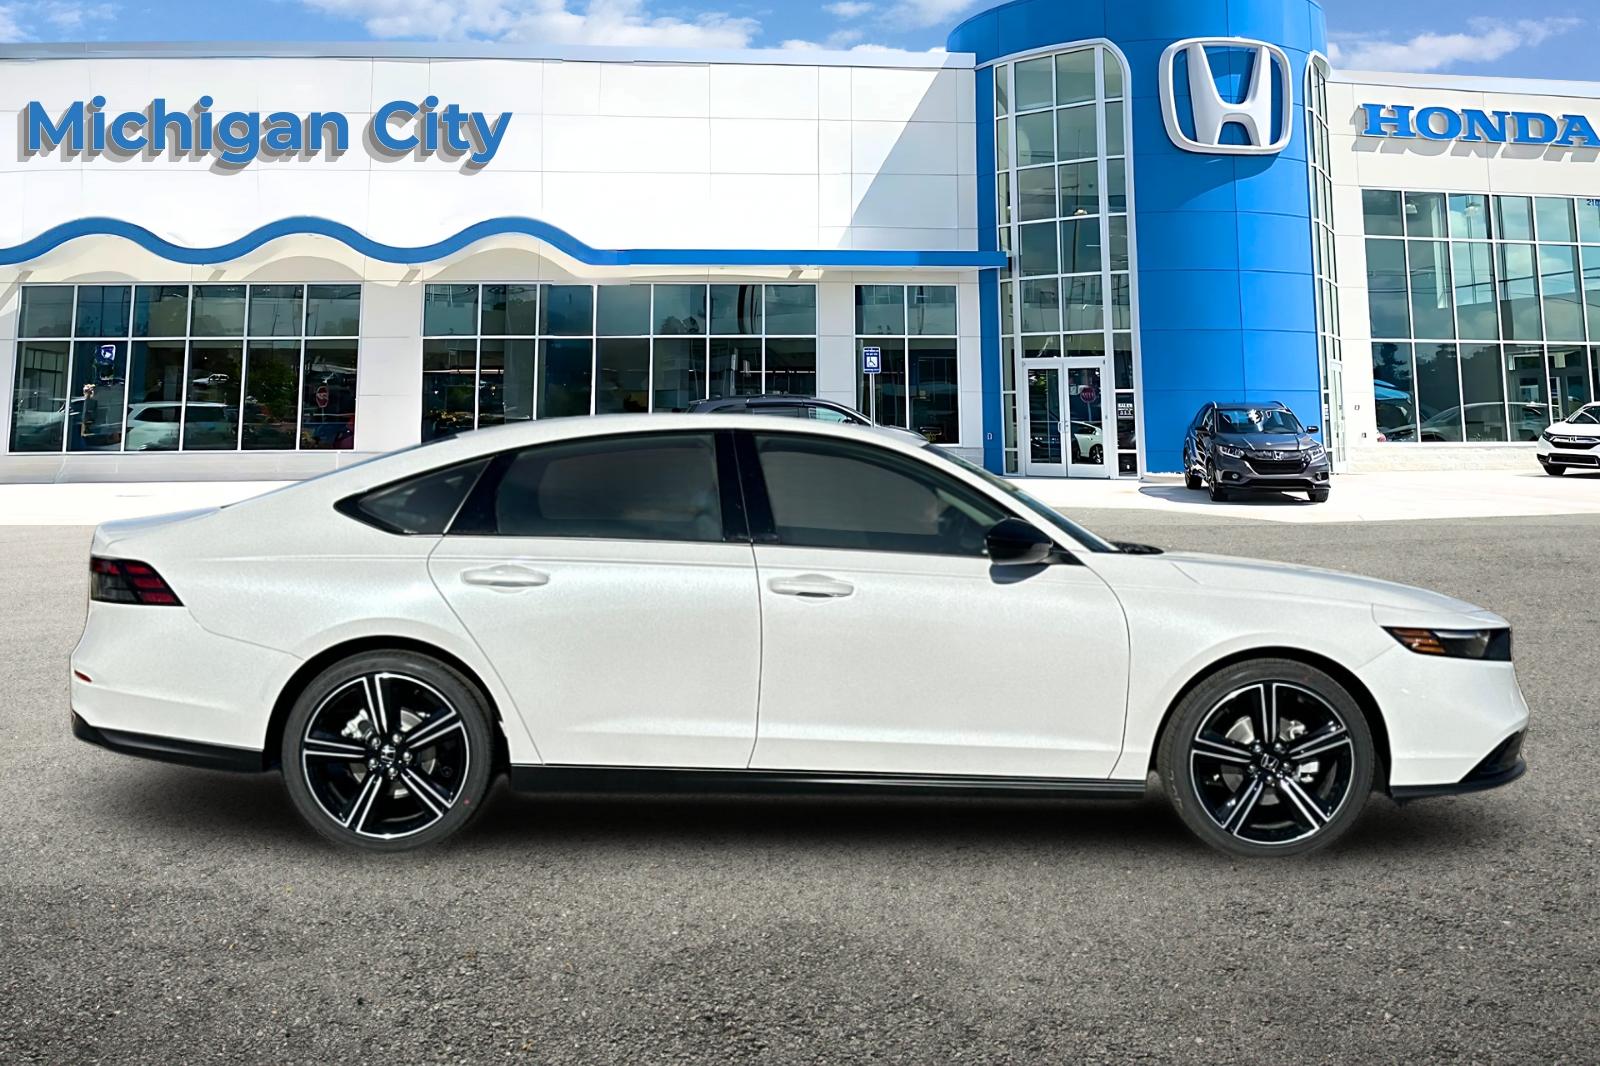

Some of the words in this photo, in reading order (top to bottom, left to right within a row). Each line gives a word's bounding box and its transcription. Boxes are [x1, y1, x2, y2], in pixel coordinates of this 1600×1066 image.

[29, 96, 349, 164] Michigan
[374, 96, 512, 164] City
[1362, 103, 1600, 147] HONDA
